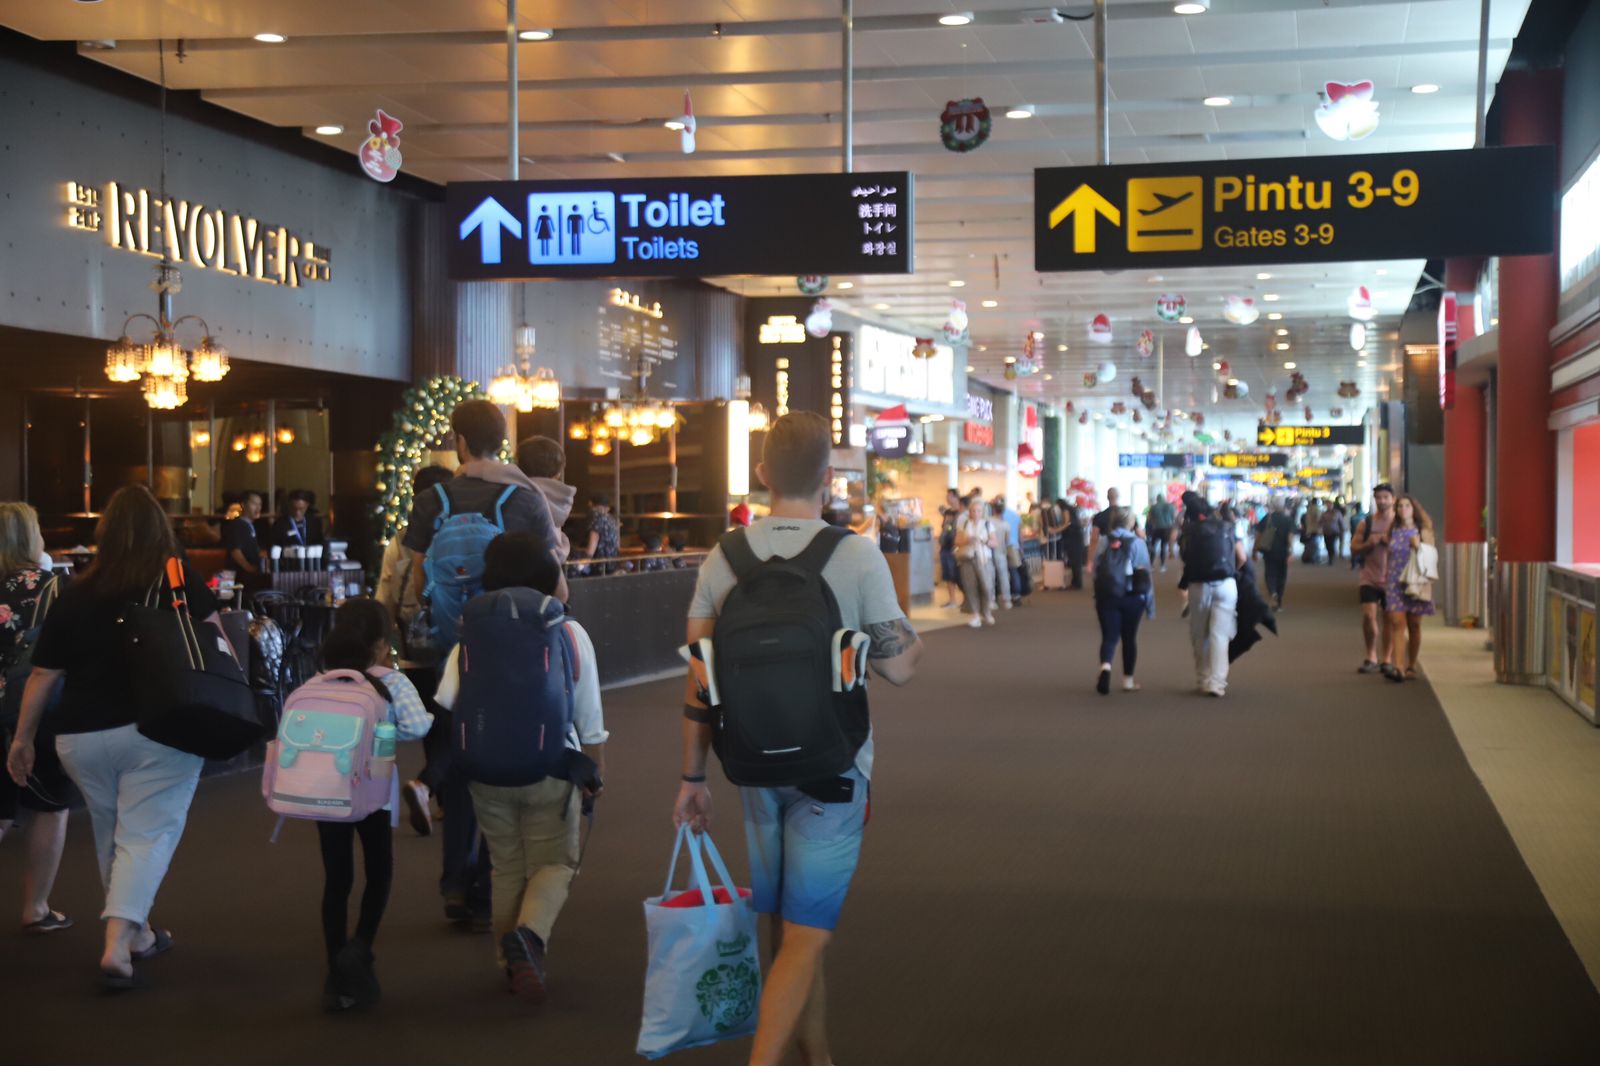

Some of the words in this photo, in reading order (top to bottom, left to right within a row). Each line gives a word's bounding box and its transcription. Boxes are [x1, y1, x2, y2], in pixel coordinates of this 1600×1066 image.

[1213, 175, 1332, 212] Pintu
[1347, 168, 1420, 208] 3-9
[620, 192, 726, 228] Toilet
[109, 180, 303, 289] REVOLVER
[863, 221, 897, 235] トイレ
[1214, 225, 1287, 248] Gates
[1294, 222, 1335, 246] 3-9
[621, 235, 700, 260] Toilets
[862, 240, 897, 256] 화장실
